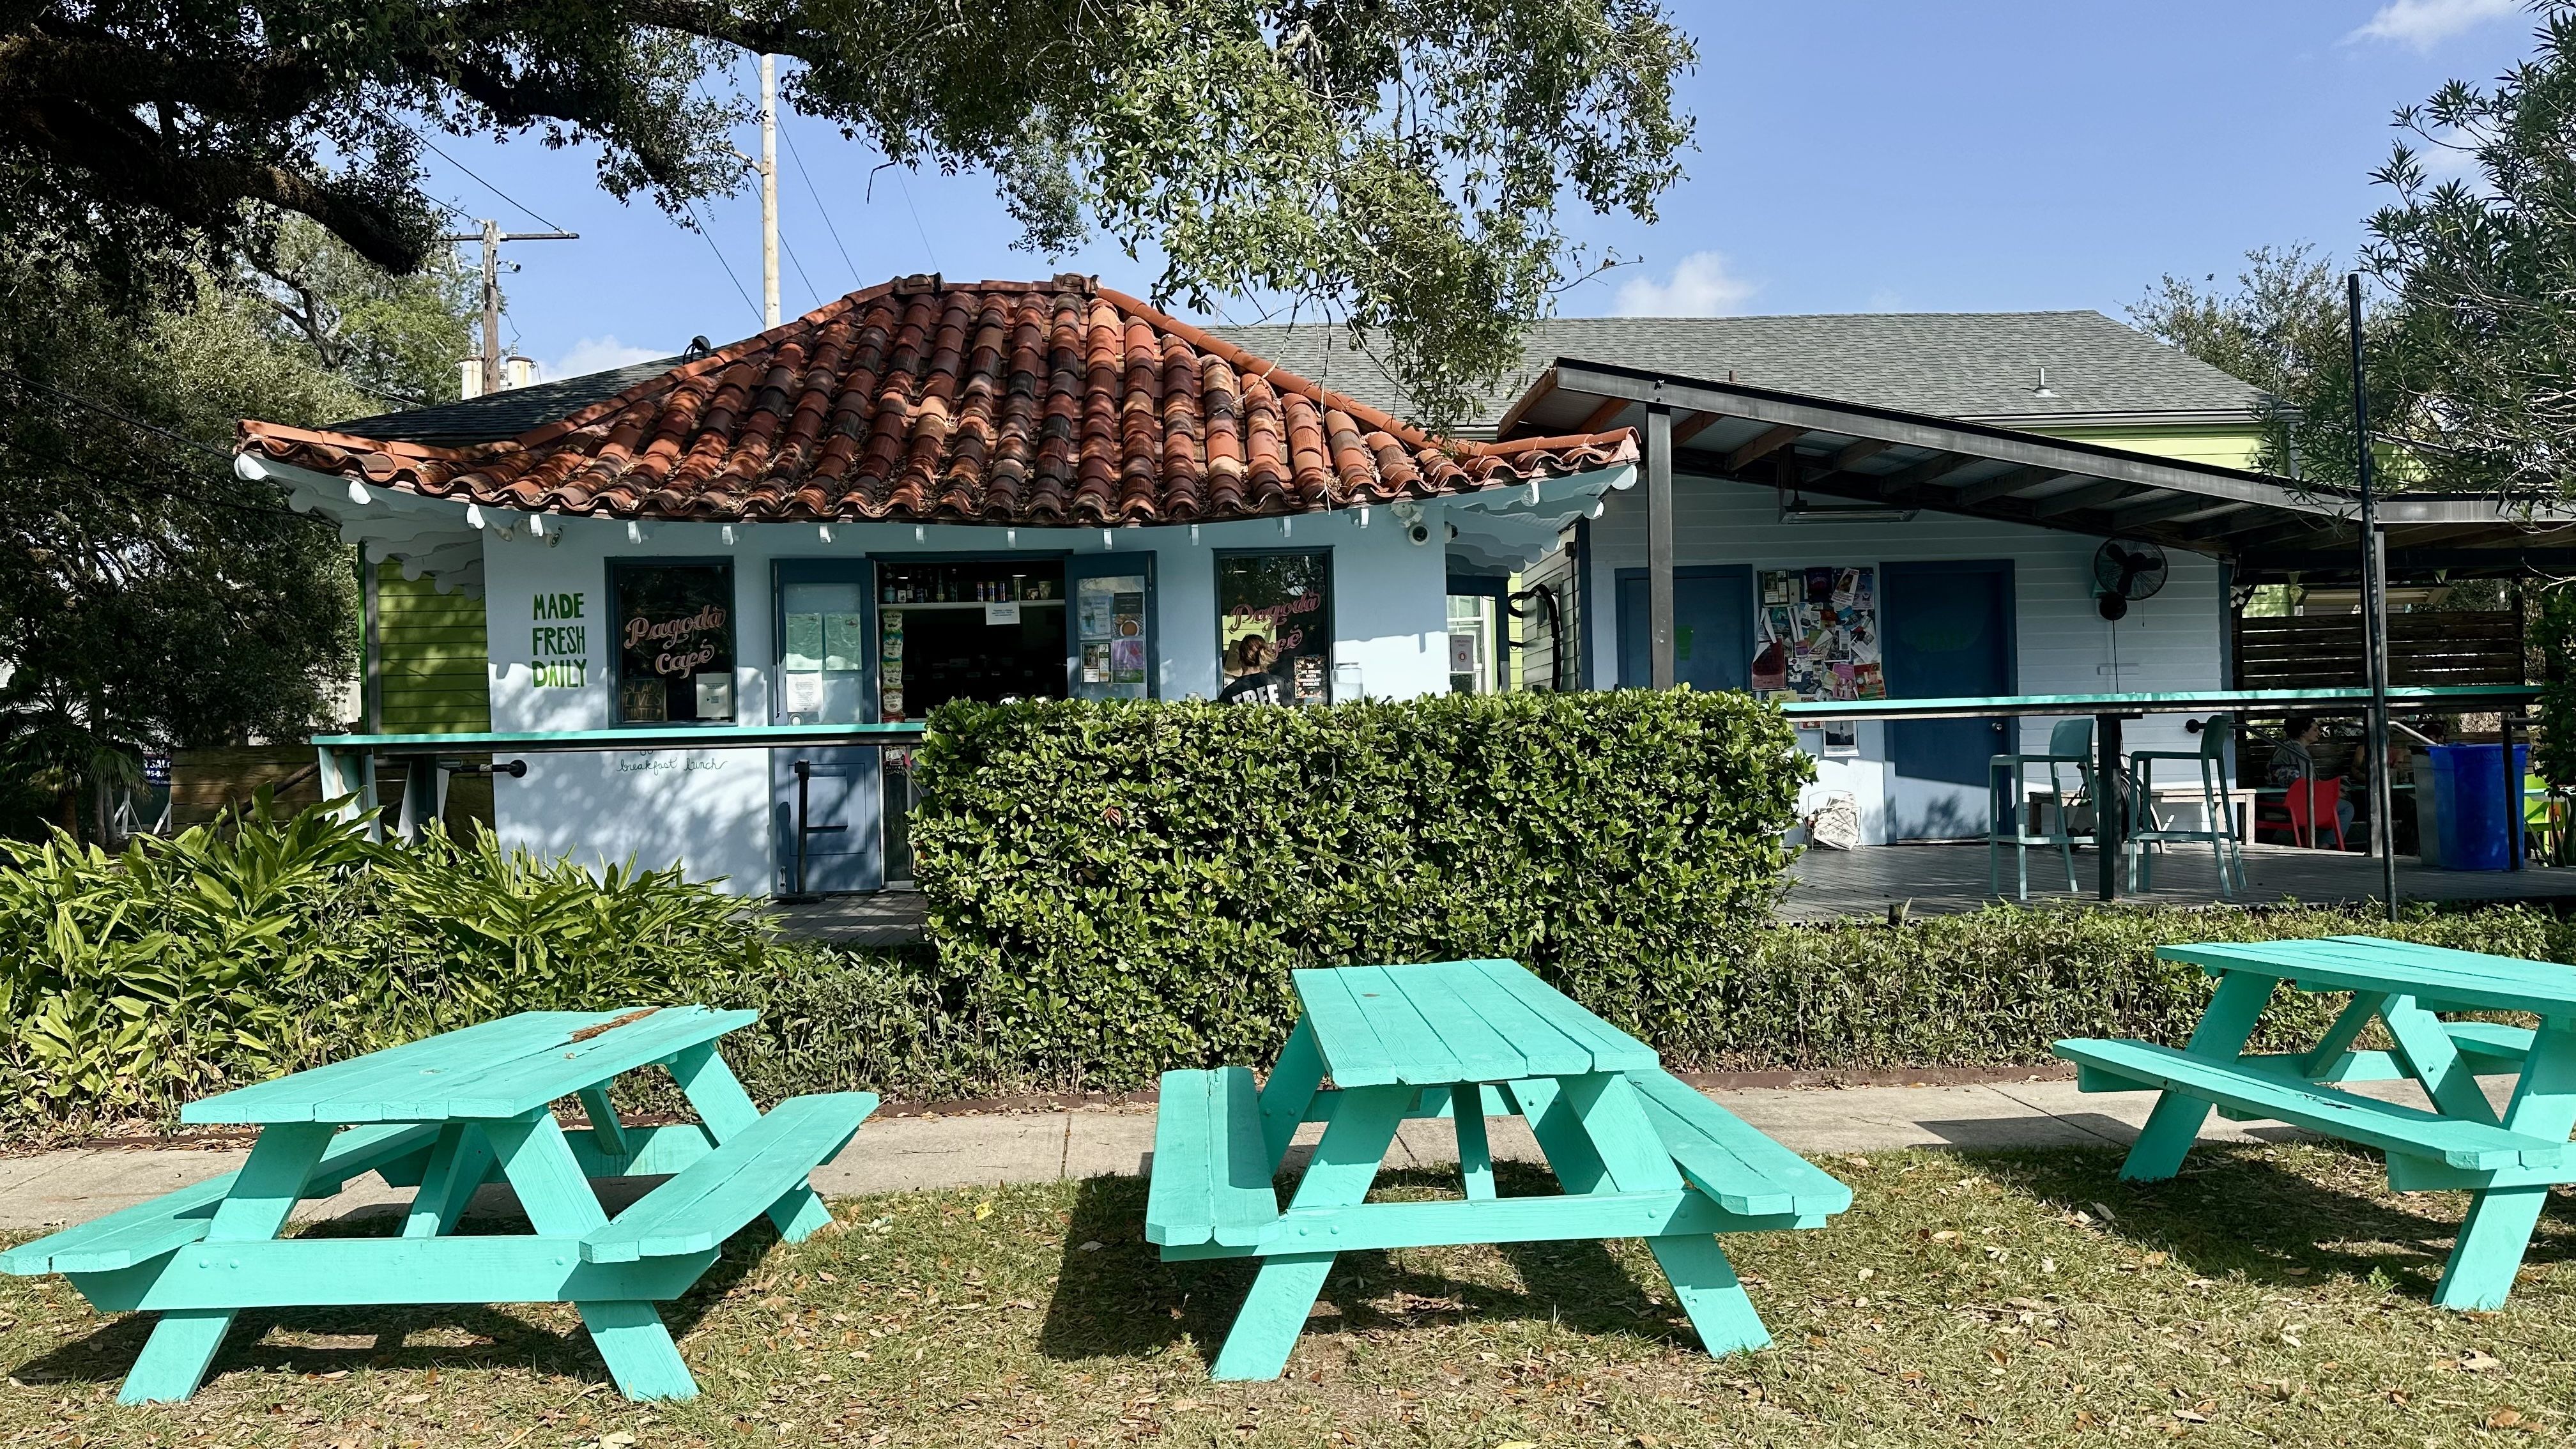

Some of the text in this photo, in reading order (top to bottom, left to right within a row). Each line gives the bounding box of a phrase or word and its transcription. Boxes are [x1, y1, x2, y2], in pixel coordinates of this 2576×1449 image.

[533, 593, 584, 620] MADE
[1229, 592, 1321, 634] Pagoda
[532, 626, 585, 656] FRESH
[624, 605, 726, 650] Pagoda
[656, 639, 715, 678] Café
[532, 659, 587, 687] DAILY
[625, 693, 661, 707] LIVES
[1232, 684, 1280, 707] FREE
[616, 757, 728, 776] breakfast lunch
